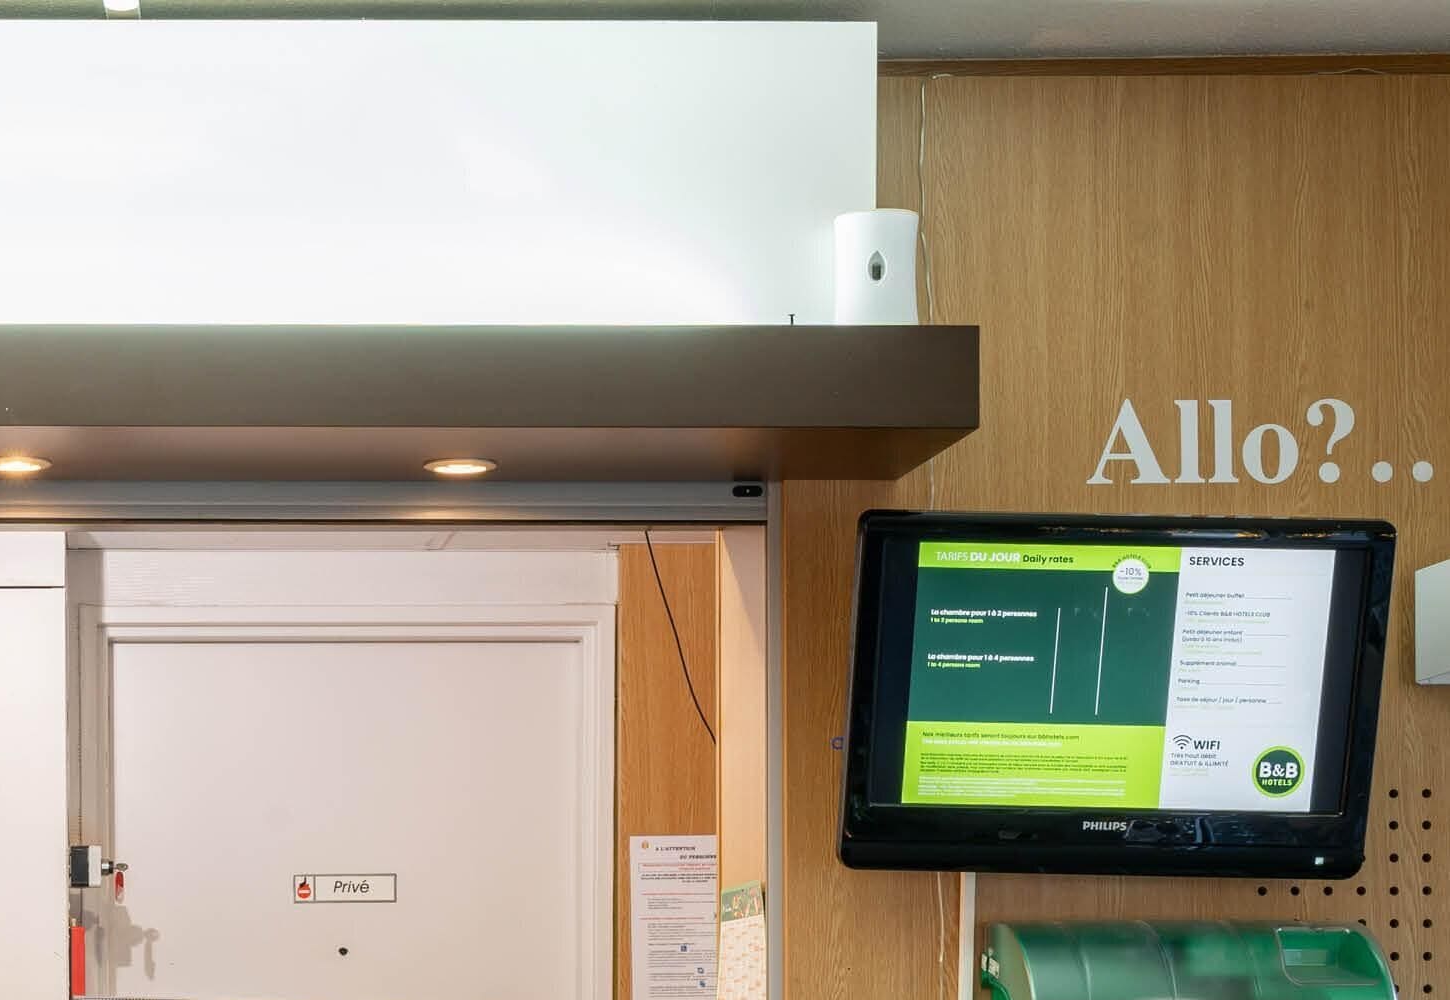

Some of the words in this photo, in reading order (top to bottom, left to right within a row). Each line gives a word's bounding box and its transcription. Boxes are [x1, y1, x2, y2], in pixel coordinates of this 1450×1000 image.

[970, 552, 987, 562] DU
[990, 552, 1020, 563] JOUR
[1023, 554, 1047, 566] Daily
[1049, 555, 1074, 564] rates
[1189, 556, 1245, 567] SERVICES
[1193, 740, 1220, 750] WIFI
[1259, 761, 1298, 779] B&B
[1261, 778, 1293, 786] HOTELS
[1082, 820, 1127, 831] PHILIPS
[333, 880, 370, 893] Privé
